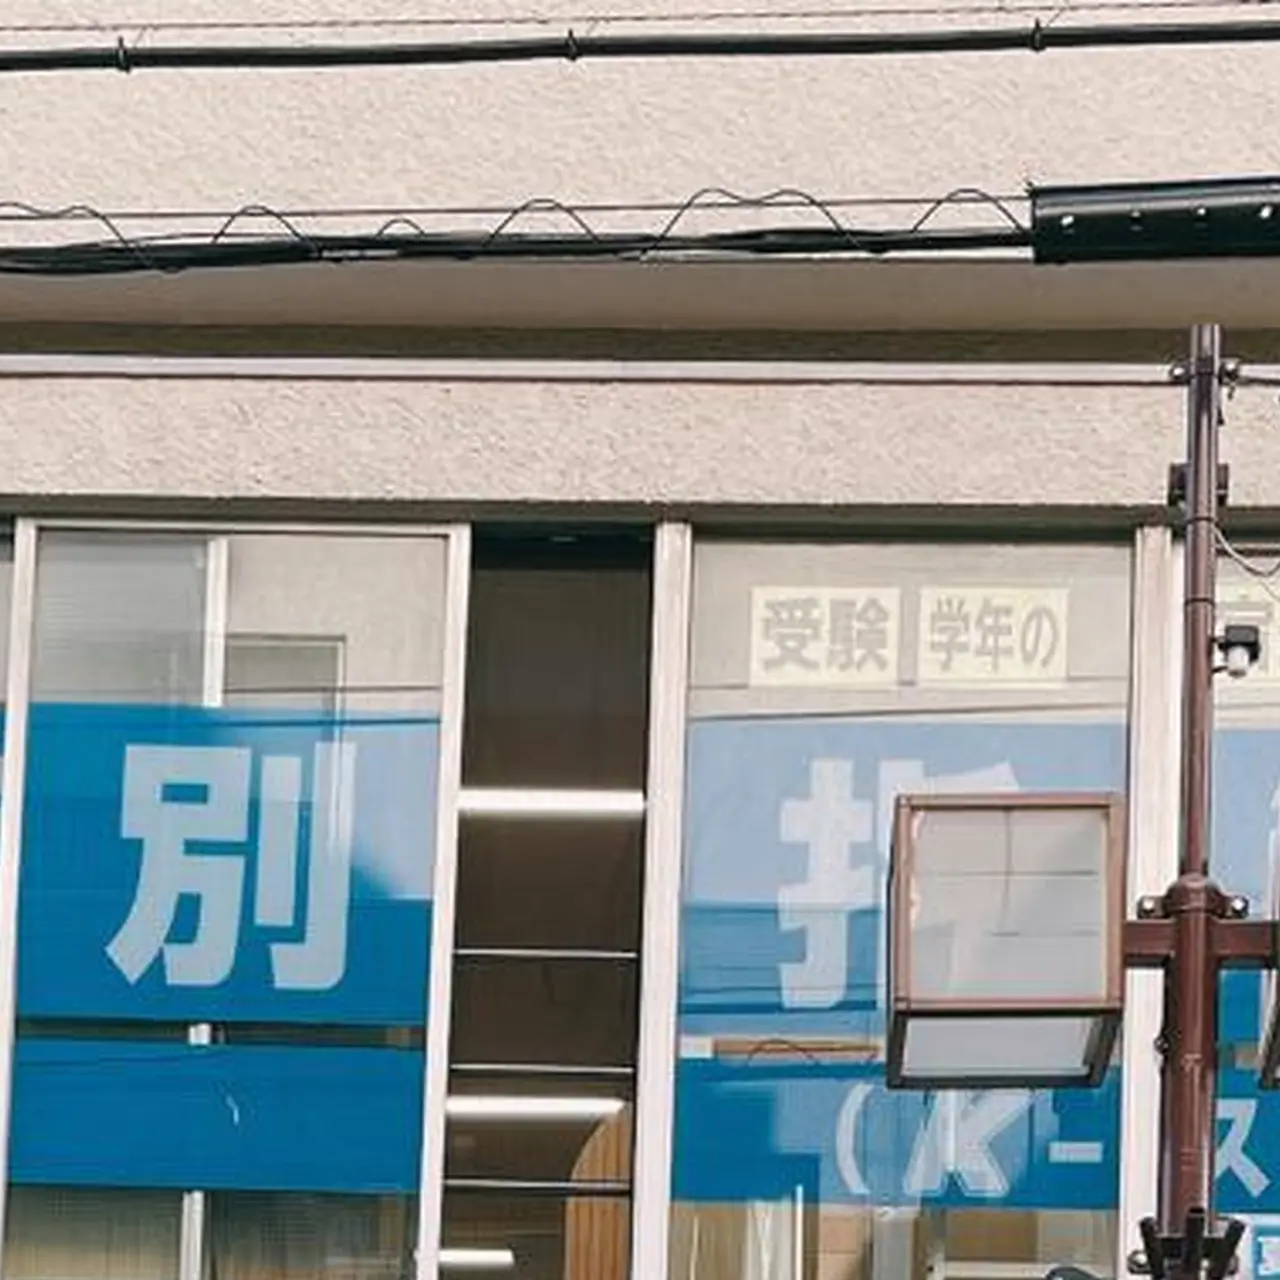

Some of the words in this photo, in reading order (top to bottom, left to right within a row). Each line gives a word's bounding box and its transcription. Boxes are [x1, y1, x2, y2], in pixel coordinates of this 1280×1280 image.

[763, 597, 888, 674] 受験
[928, 598, 1058, 674] 学年の
